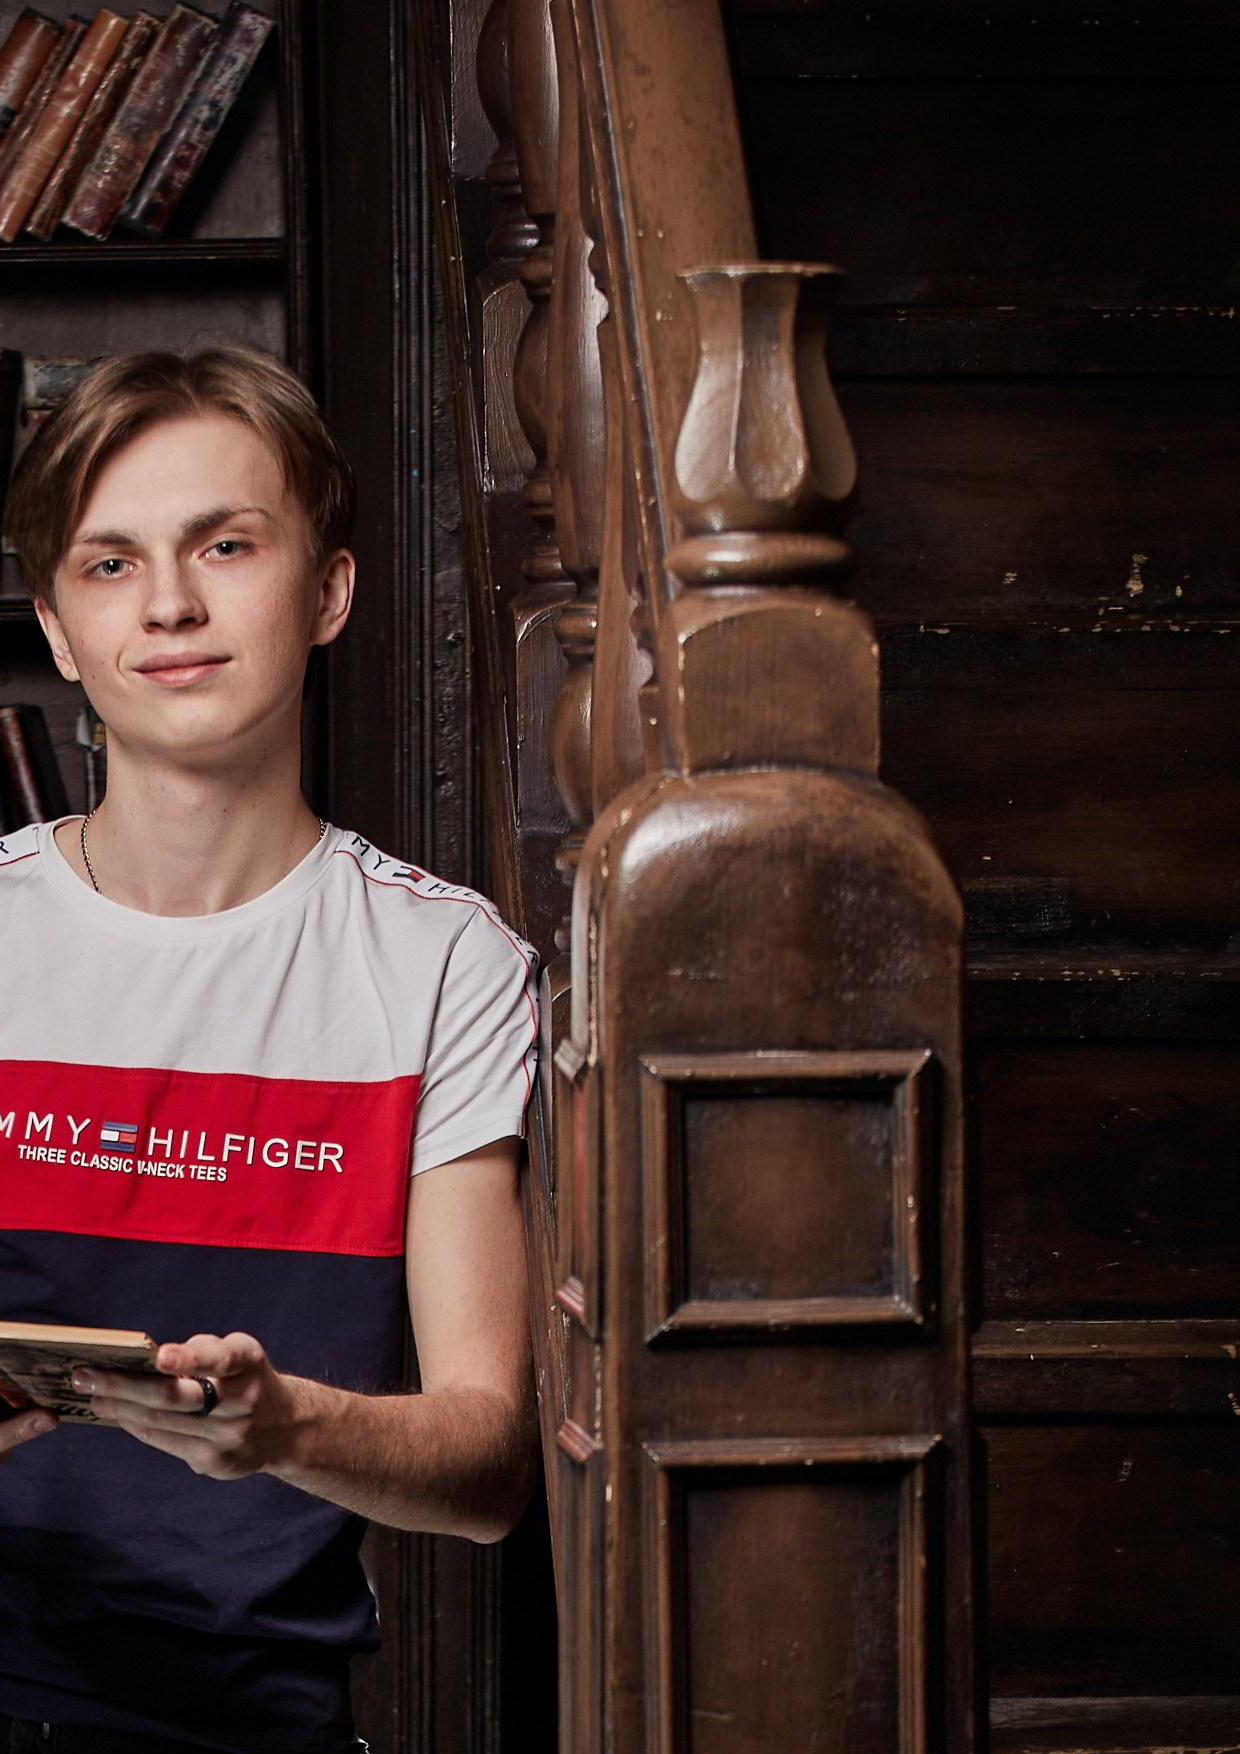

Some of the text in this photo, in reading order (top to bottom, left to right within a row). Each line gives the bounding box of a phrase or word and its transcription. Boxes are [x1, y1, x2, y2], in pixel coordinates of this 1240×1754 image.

[17, 1144, 228, 1182] THREE CLASSIC V-NECK TEES
[147, 1126, 344, 1173] HILFIGER
